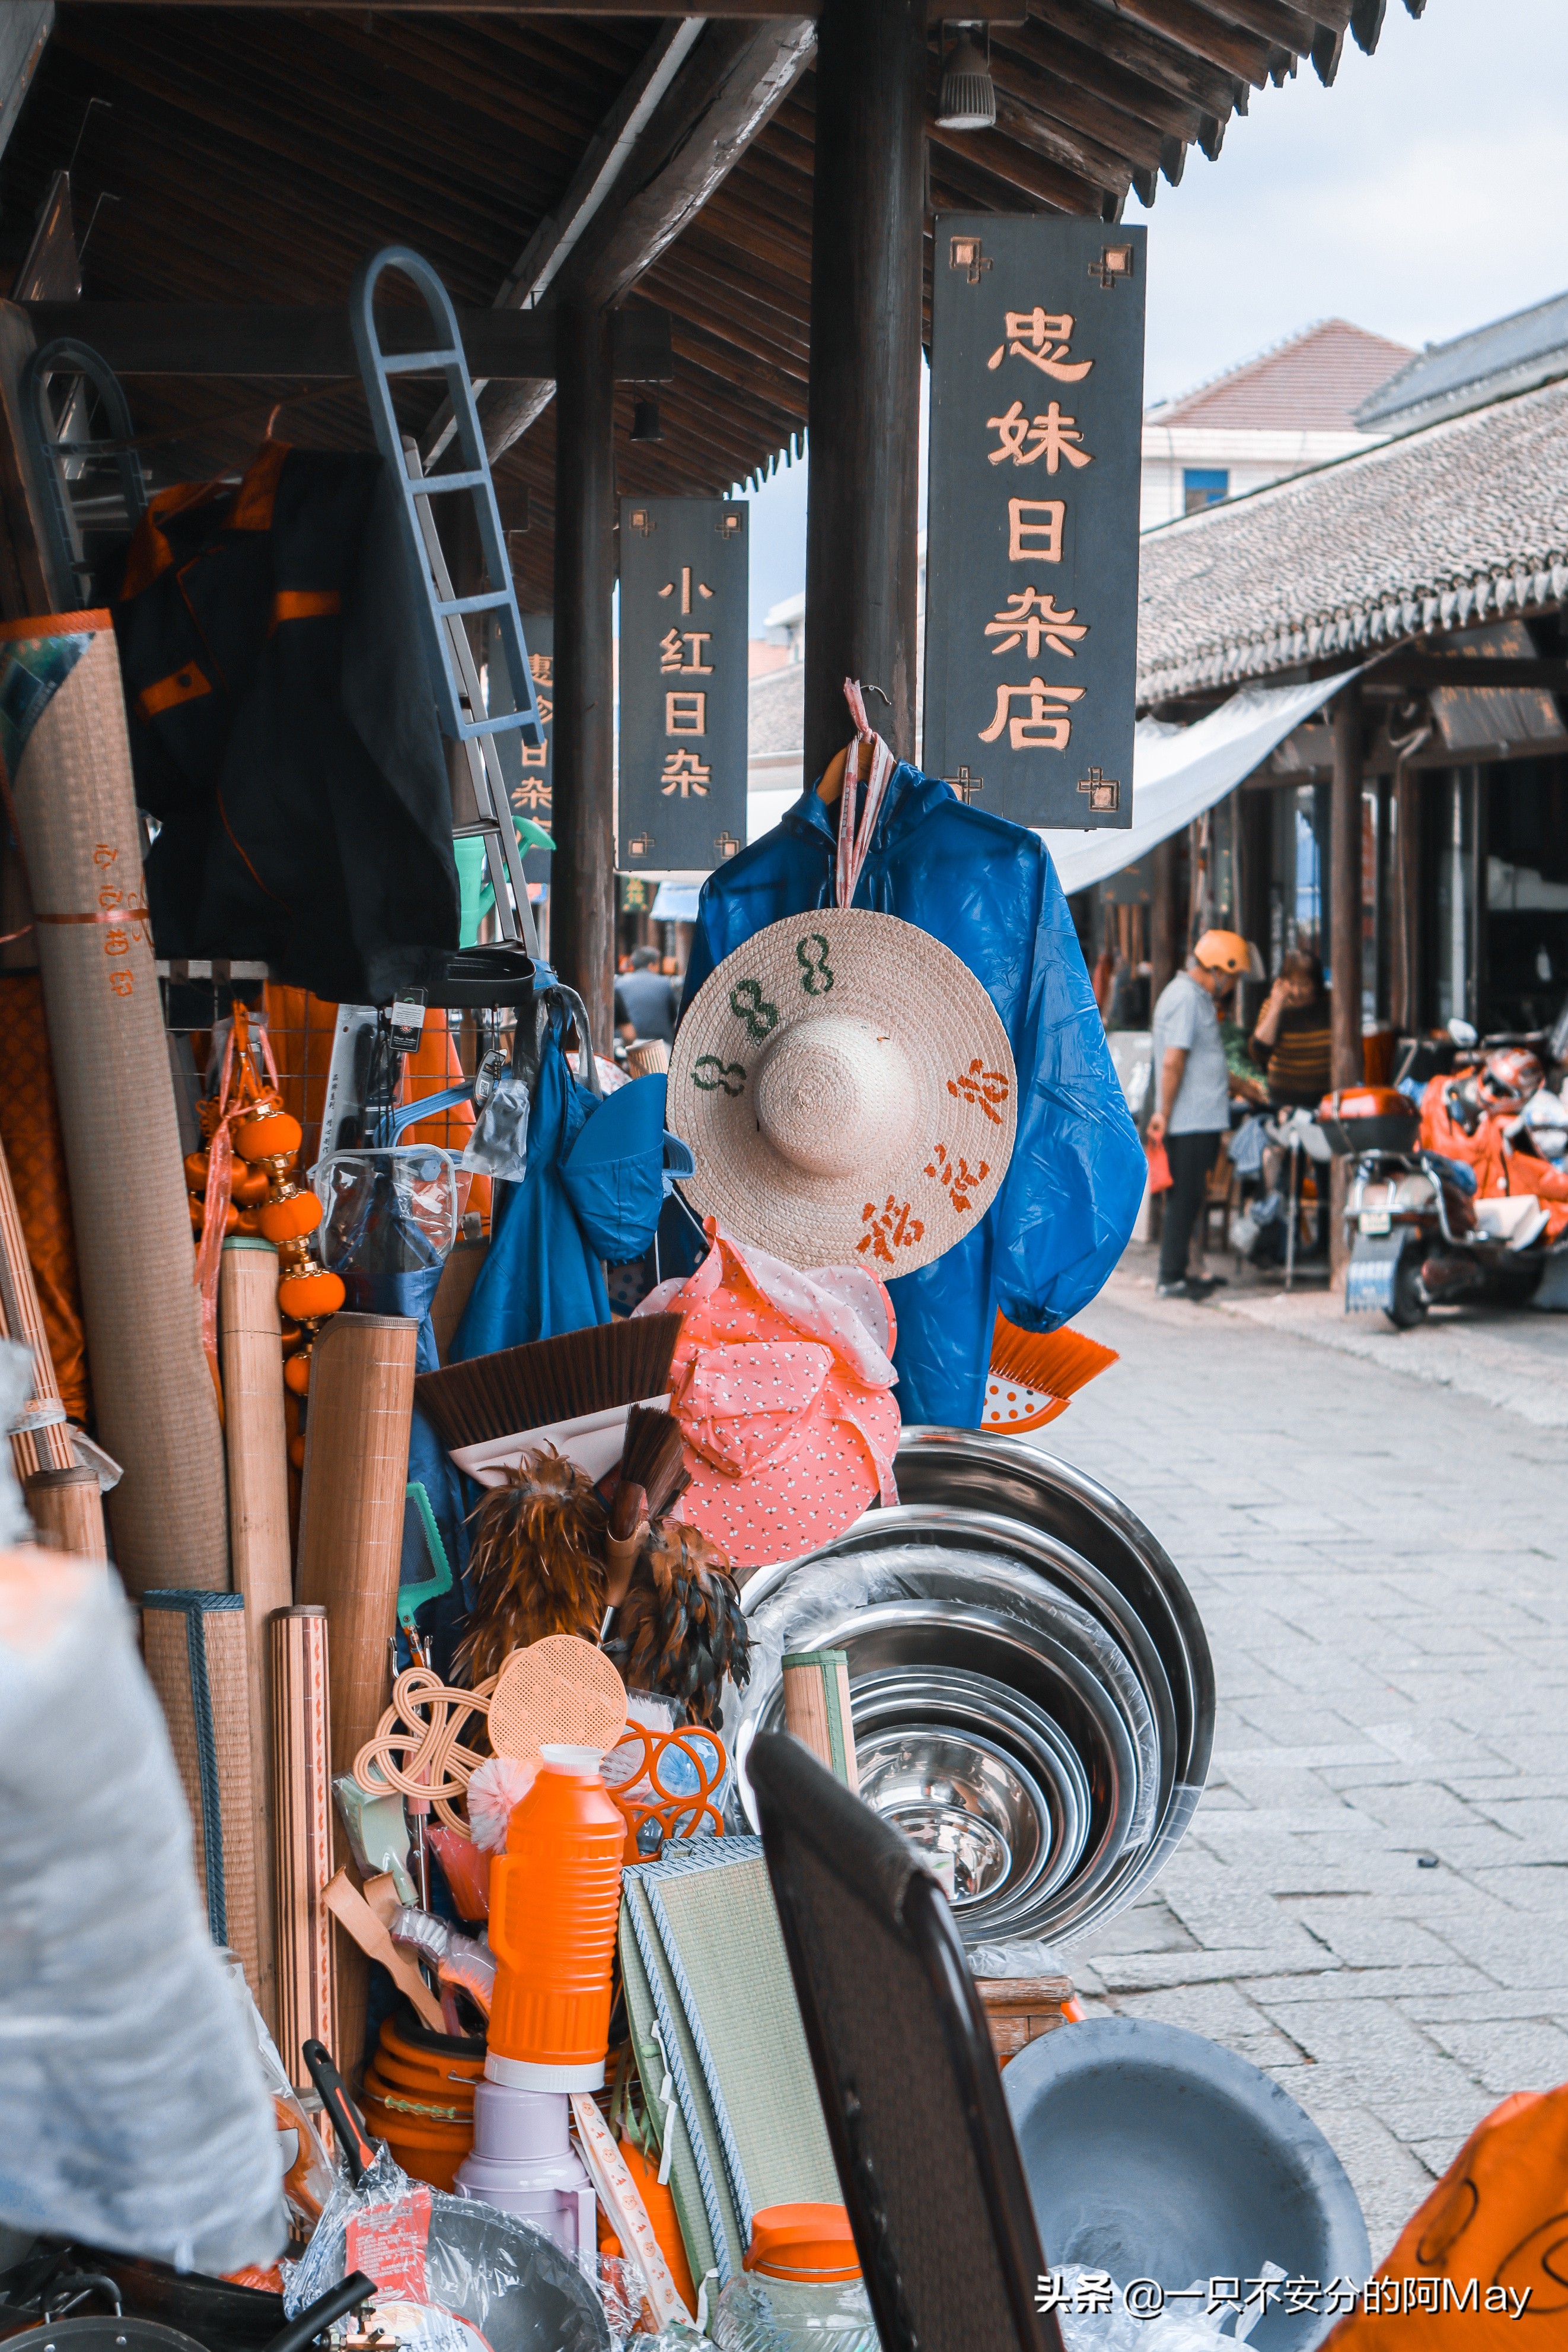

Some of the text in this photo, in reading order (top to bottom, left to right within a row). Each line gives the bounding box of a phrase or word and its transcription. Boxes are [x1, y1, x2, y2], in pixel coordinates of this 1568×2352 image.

[978, 306, 1095, 752] 忠妹日杂店
[658, 566, 714, 797] 小红日杂
[93, 844, 134, 997] 心心相印
